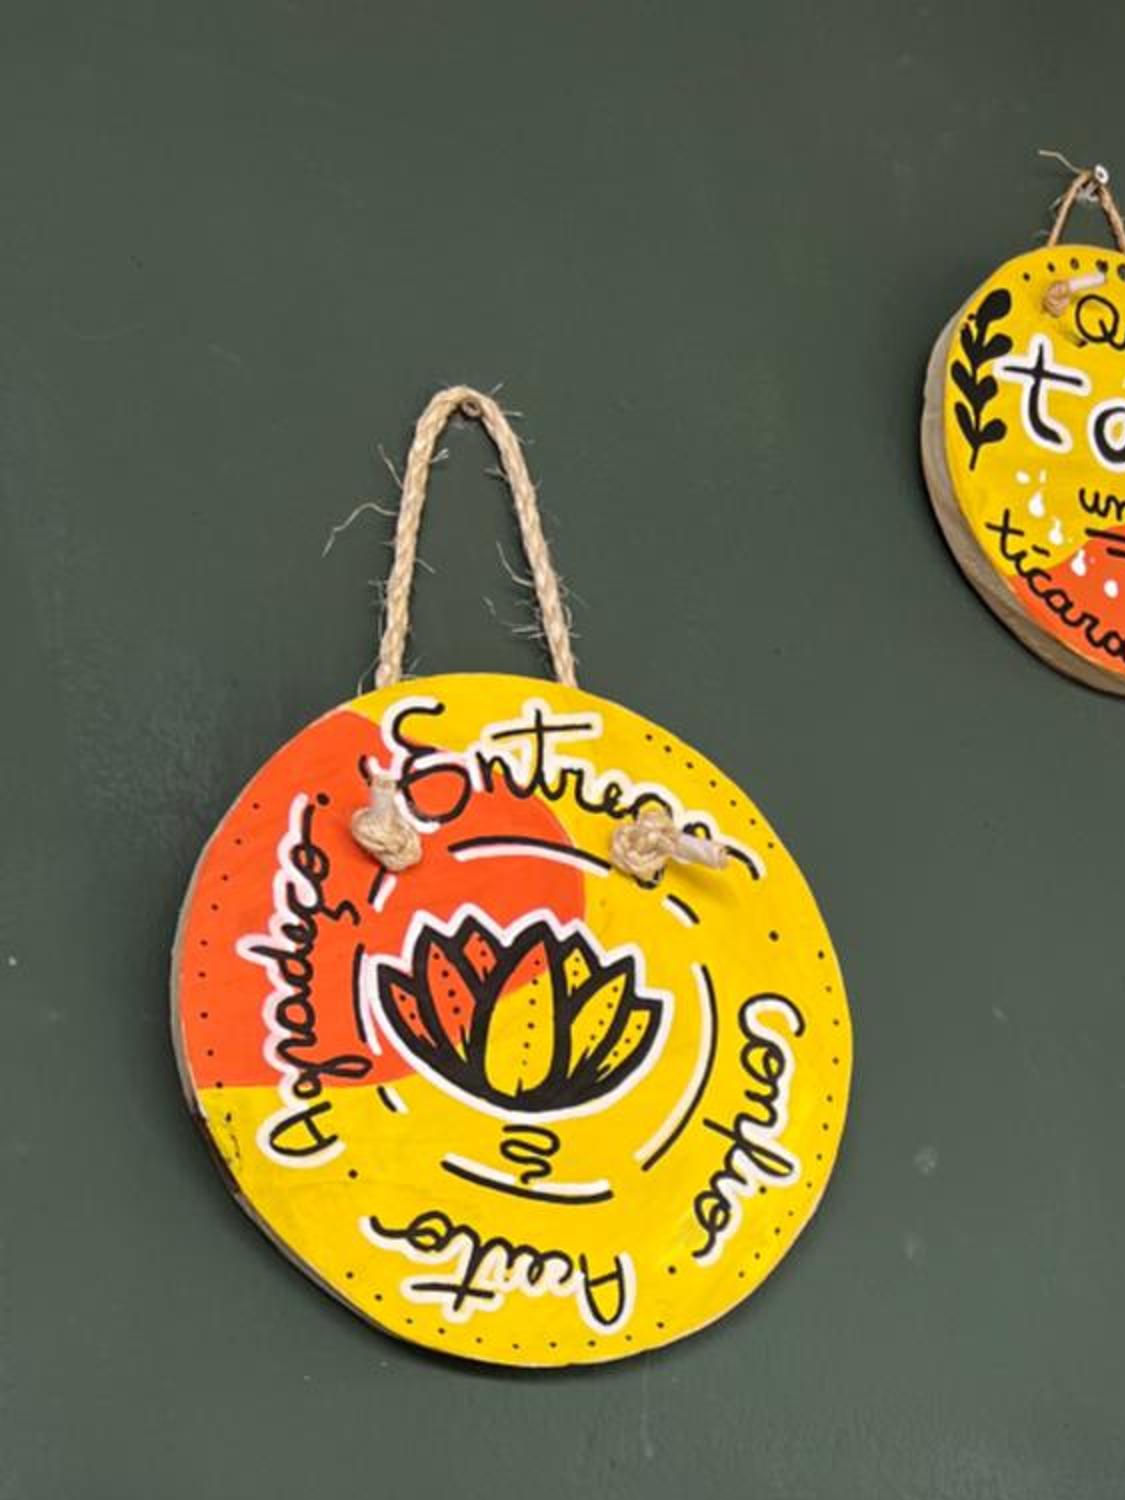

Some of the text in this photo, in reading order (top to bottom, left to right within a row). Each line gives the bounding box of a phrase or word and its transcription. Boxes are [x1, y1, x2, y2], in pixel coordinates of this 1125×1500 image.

[246, 800, 374, 1159] Agradeço
[691, 992, 806, 1258] Confio
[368, 1208, 627, 1328] Aceito
